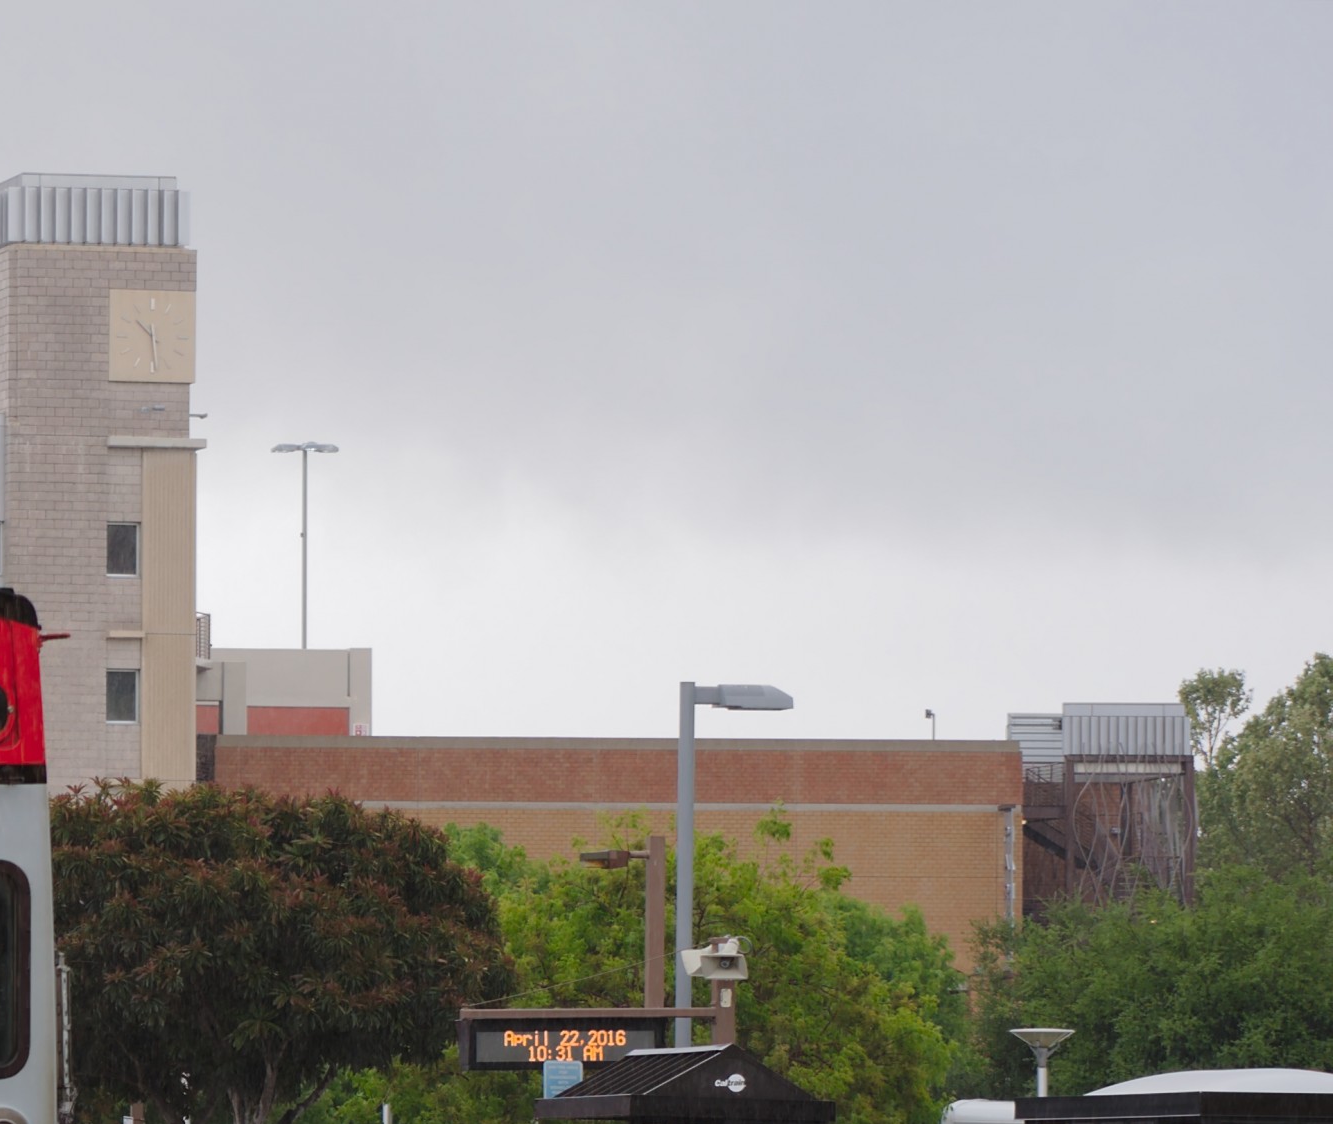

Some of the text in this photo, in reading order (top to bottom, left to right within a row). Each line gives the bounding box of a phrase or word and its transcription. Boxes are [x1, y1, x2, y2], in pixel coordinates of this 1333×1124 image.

[503, 1029, 627, 1048] April 22,2016
[528, 1045, 604, 1062] 10:31 AM
